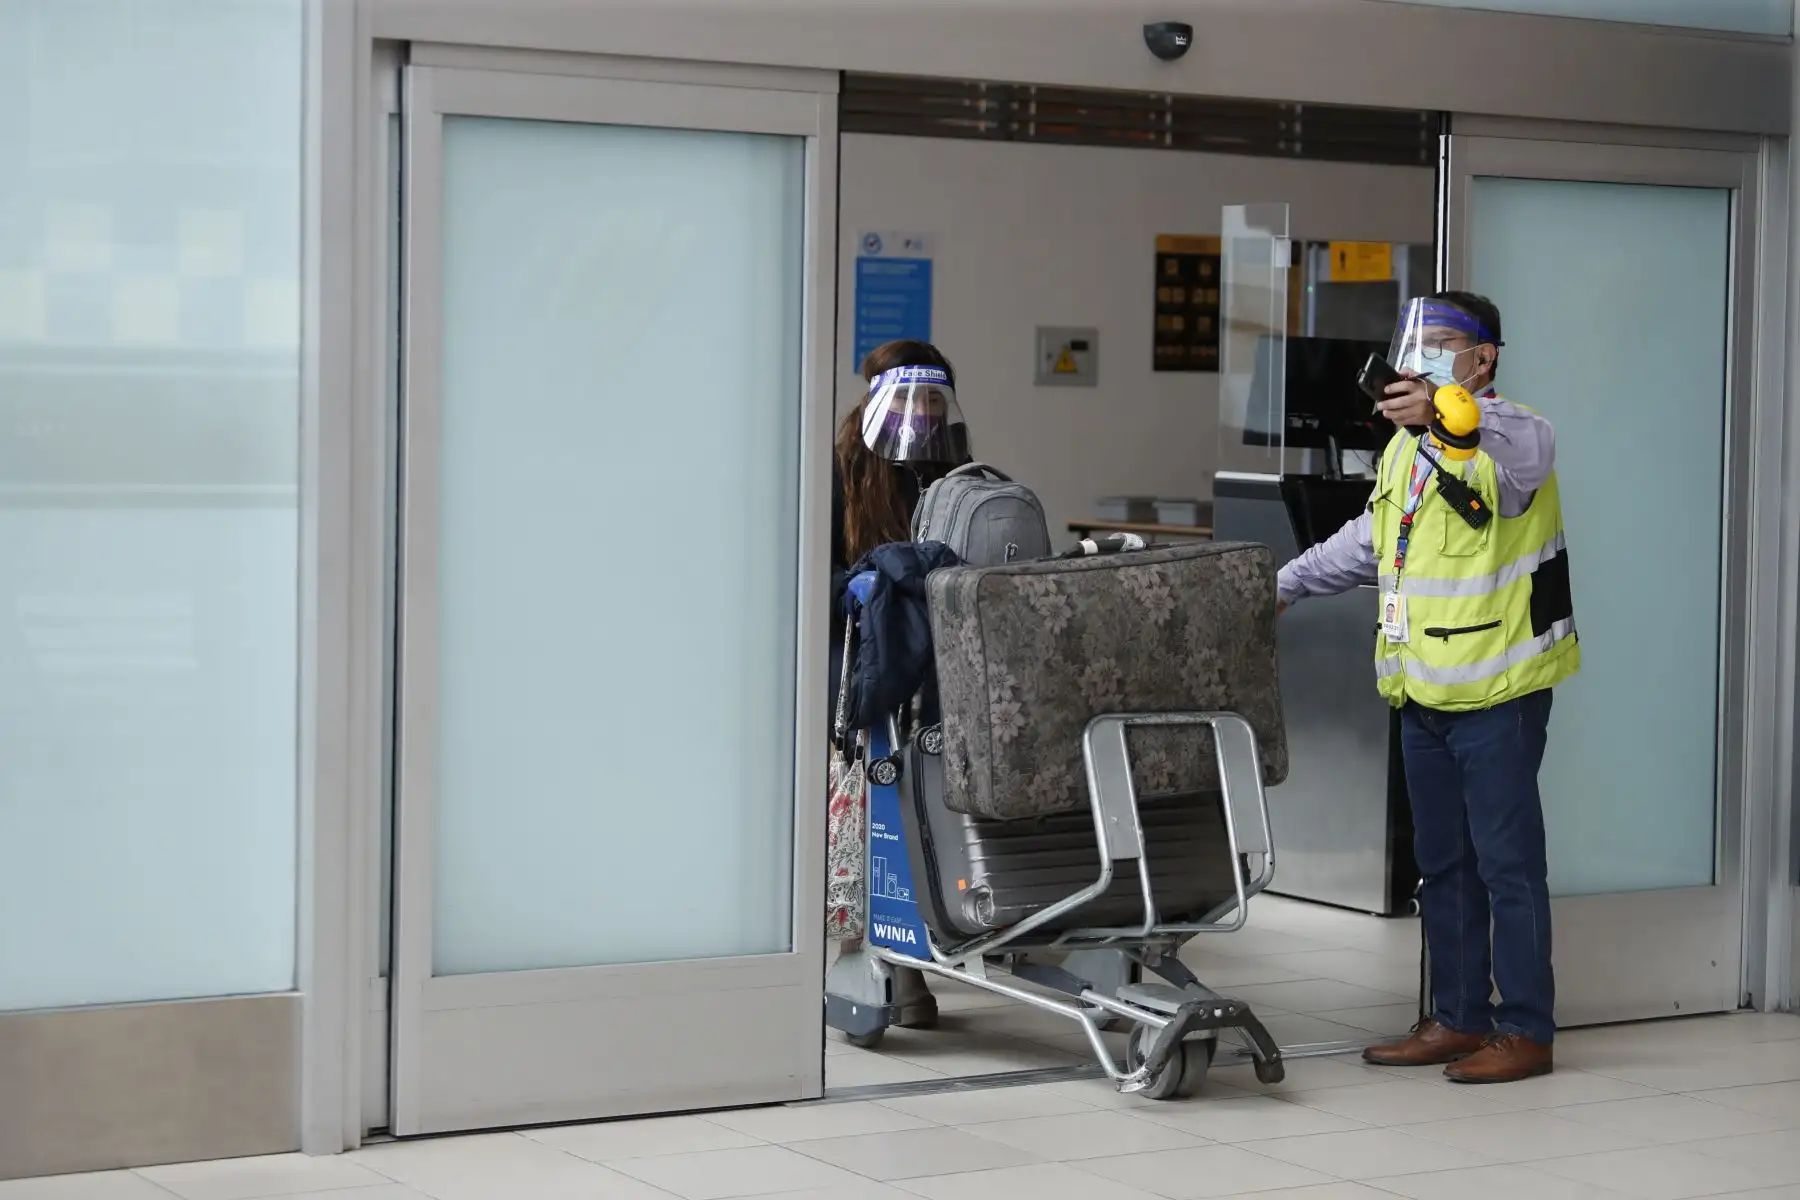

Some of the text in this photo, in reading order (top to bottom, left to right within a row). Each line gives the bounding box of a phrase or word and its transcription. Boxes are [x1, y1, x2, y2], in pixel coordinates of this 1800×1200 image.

[872, 822, 886, 831] 2020
[884, 832, 899, 841] Brand
[873, 922, 917, 945] WINIA
